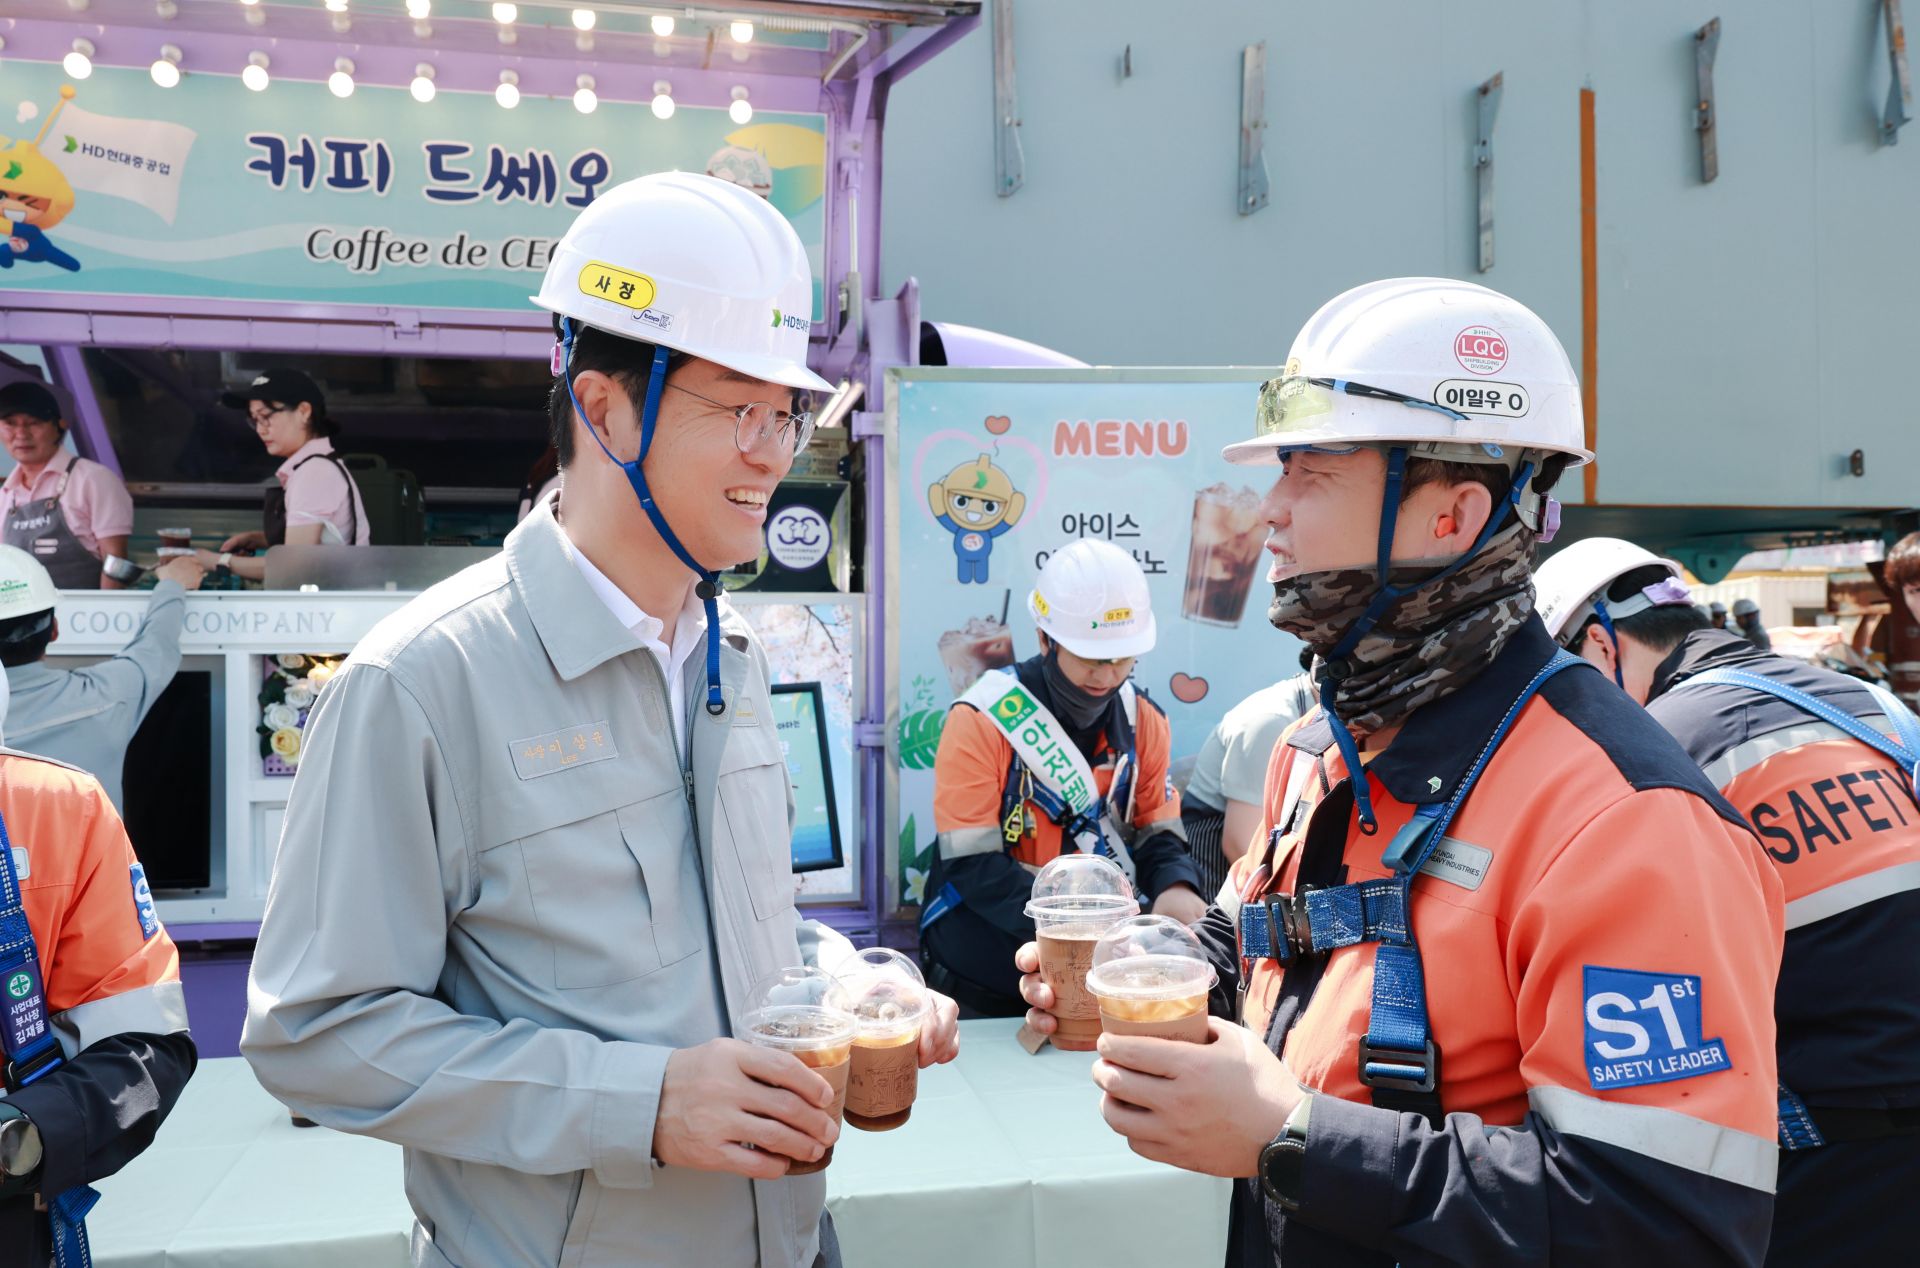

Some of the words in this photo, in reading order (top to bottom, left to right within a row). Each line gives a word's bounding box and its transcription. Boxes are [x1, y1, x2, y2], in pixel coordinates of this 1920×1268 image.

[81, 142, 171, 176] HD현대중공업
[248, 135, 392, 194] 커피
[424, 143, 610, 207] 드쎄오
[306, 228, 429, 271] Coffee
[441, 234, 488, 267] de
[1461, 337, 1504, 358] LQC
[1470, 363, 1493, 371] DIVISION
[1446, 388, 1502, 409] 이일우
[1054, 421, 1188, 457] MENU
[1061, 512, 1142, 541] 아이스
[183, 611, 337, 634] COMPANY
[1022, 718, 1092, 815] 안전벨
[1445, 860, 1481, 877] INDUSTRIES
[10, 994, 41, 1016] 사업대표
[15, 1007, 41, 1027] 부사장
[1592, 1059, 1655, 1083] SAFETY
[1657, 1046, 1725, 1075] LEADER
